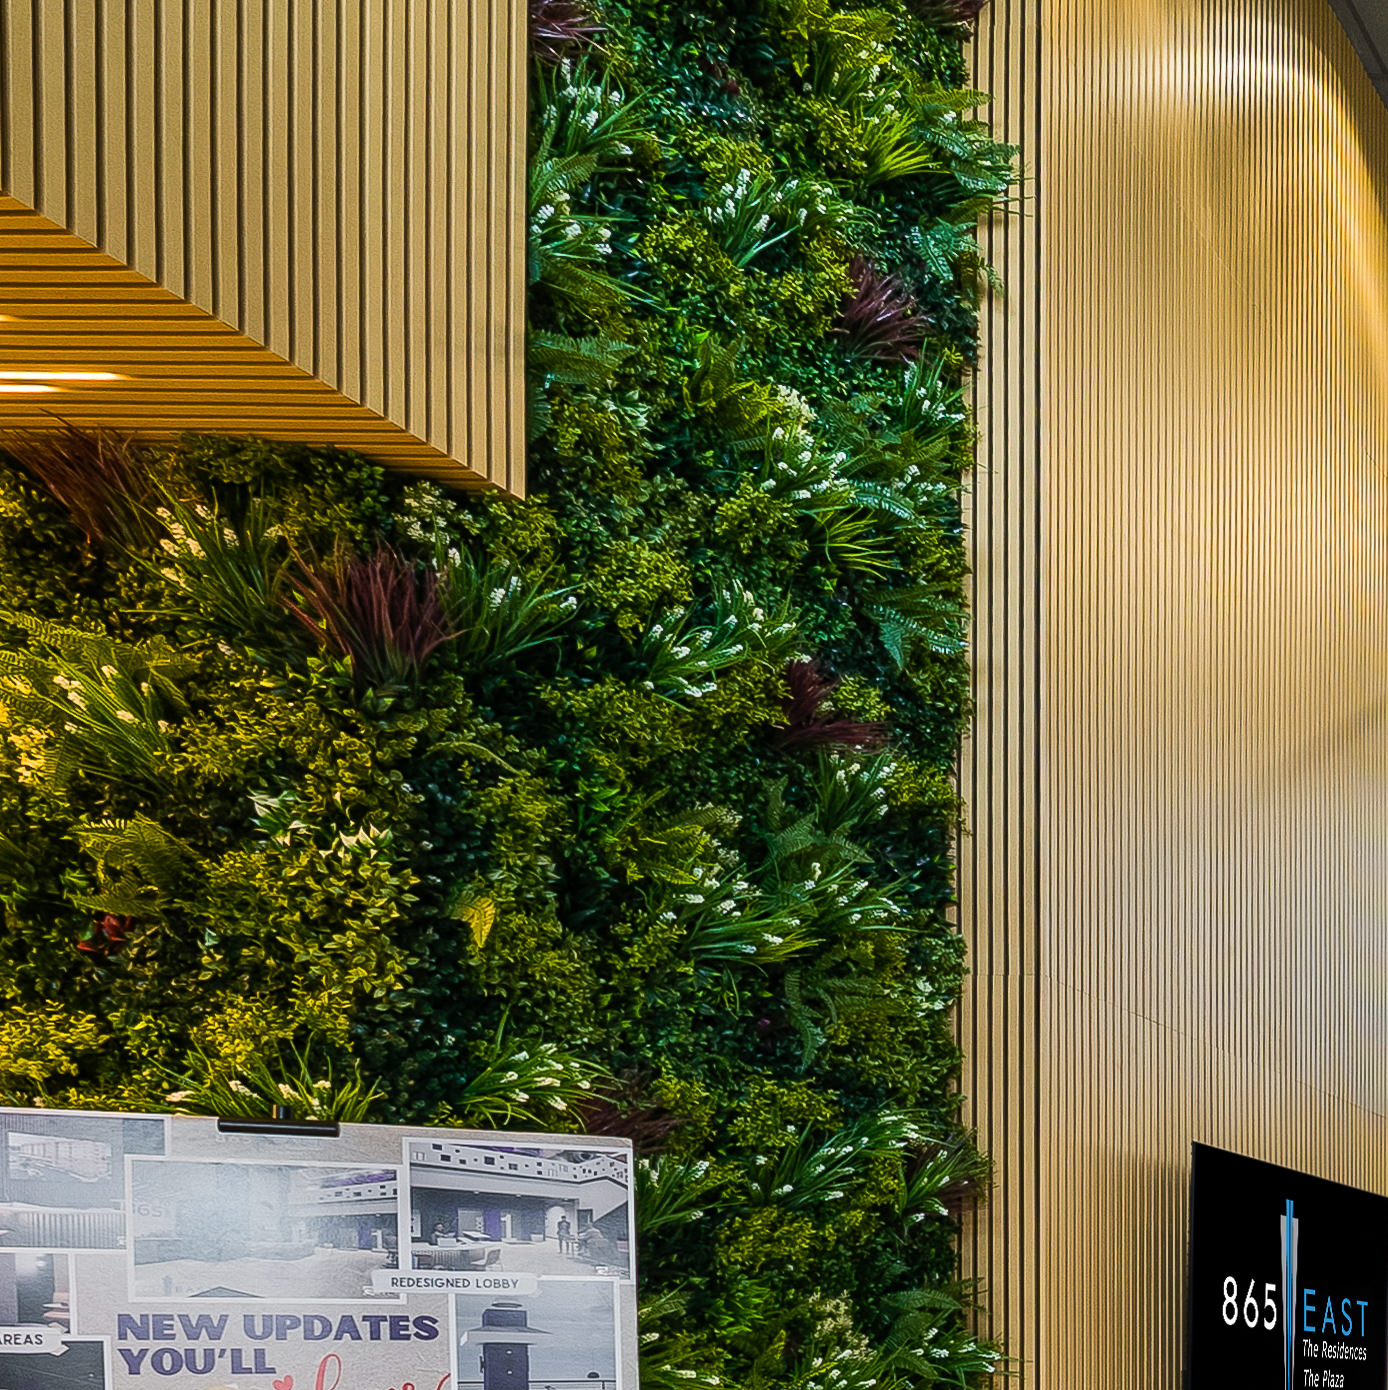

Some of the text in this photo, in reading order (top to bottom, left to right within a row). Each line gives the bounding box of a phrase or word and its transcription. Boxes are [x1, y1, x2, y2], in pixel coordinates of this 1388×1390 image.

[391, 1277, 519, 1289] REDESIGNED LOBBY
[1222, 1275, 1369, 1337] 865 EAST
[117, 1313, 440, 1341] NEW UPDATES
[0, 1333, 43, 1345] REAS
[1303, 1339, 1367, 1360] The Residences
[117, 1347, 277, 1375] YOU'LL
[1304, 1368, 1345, 1388] The Plaza
